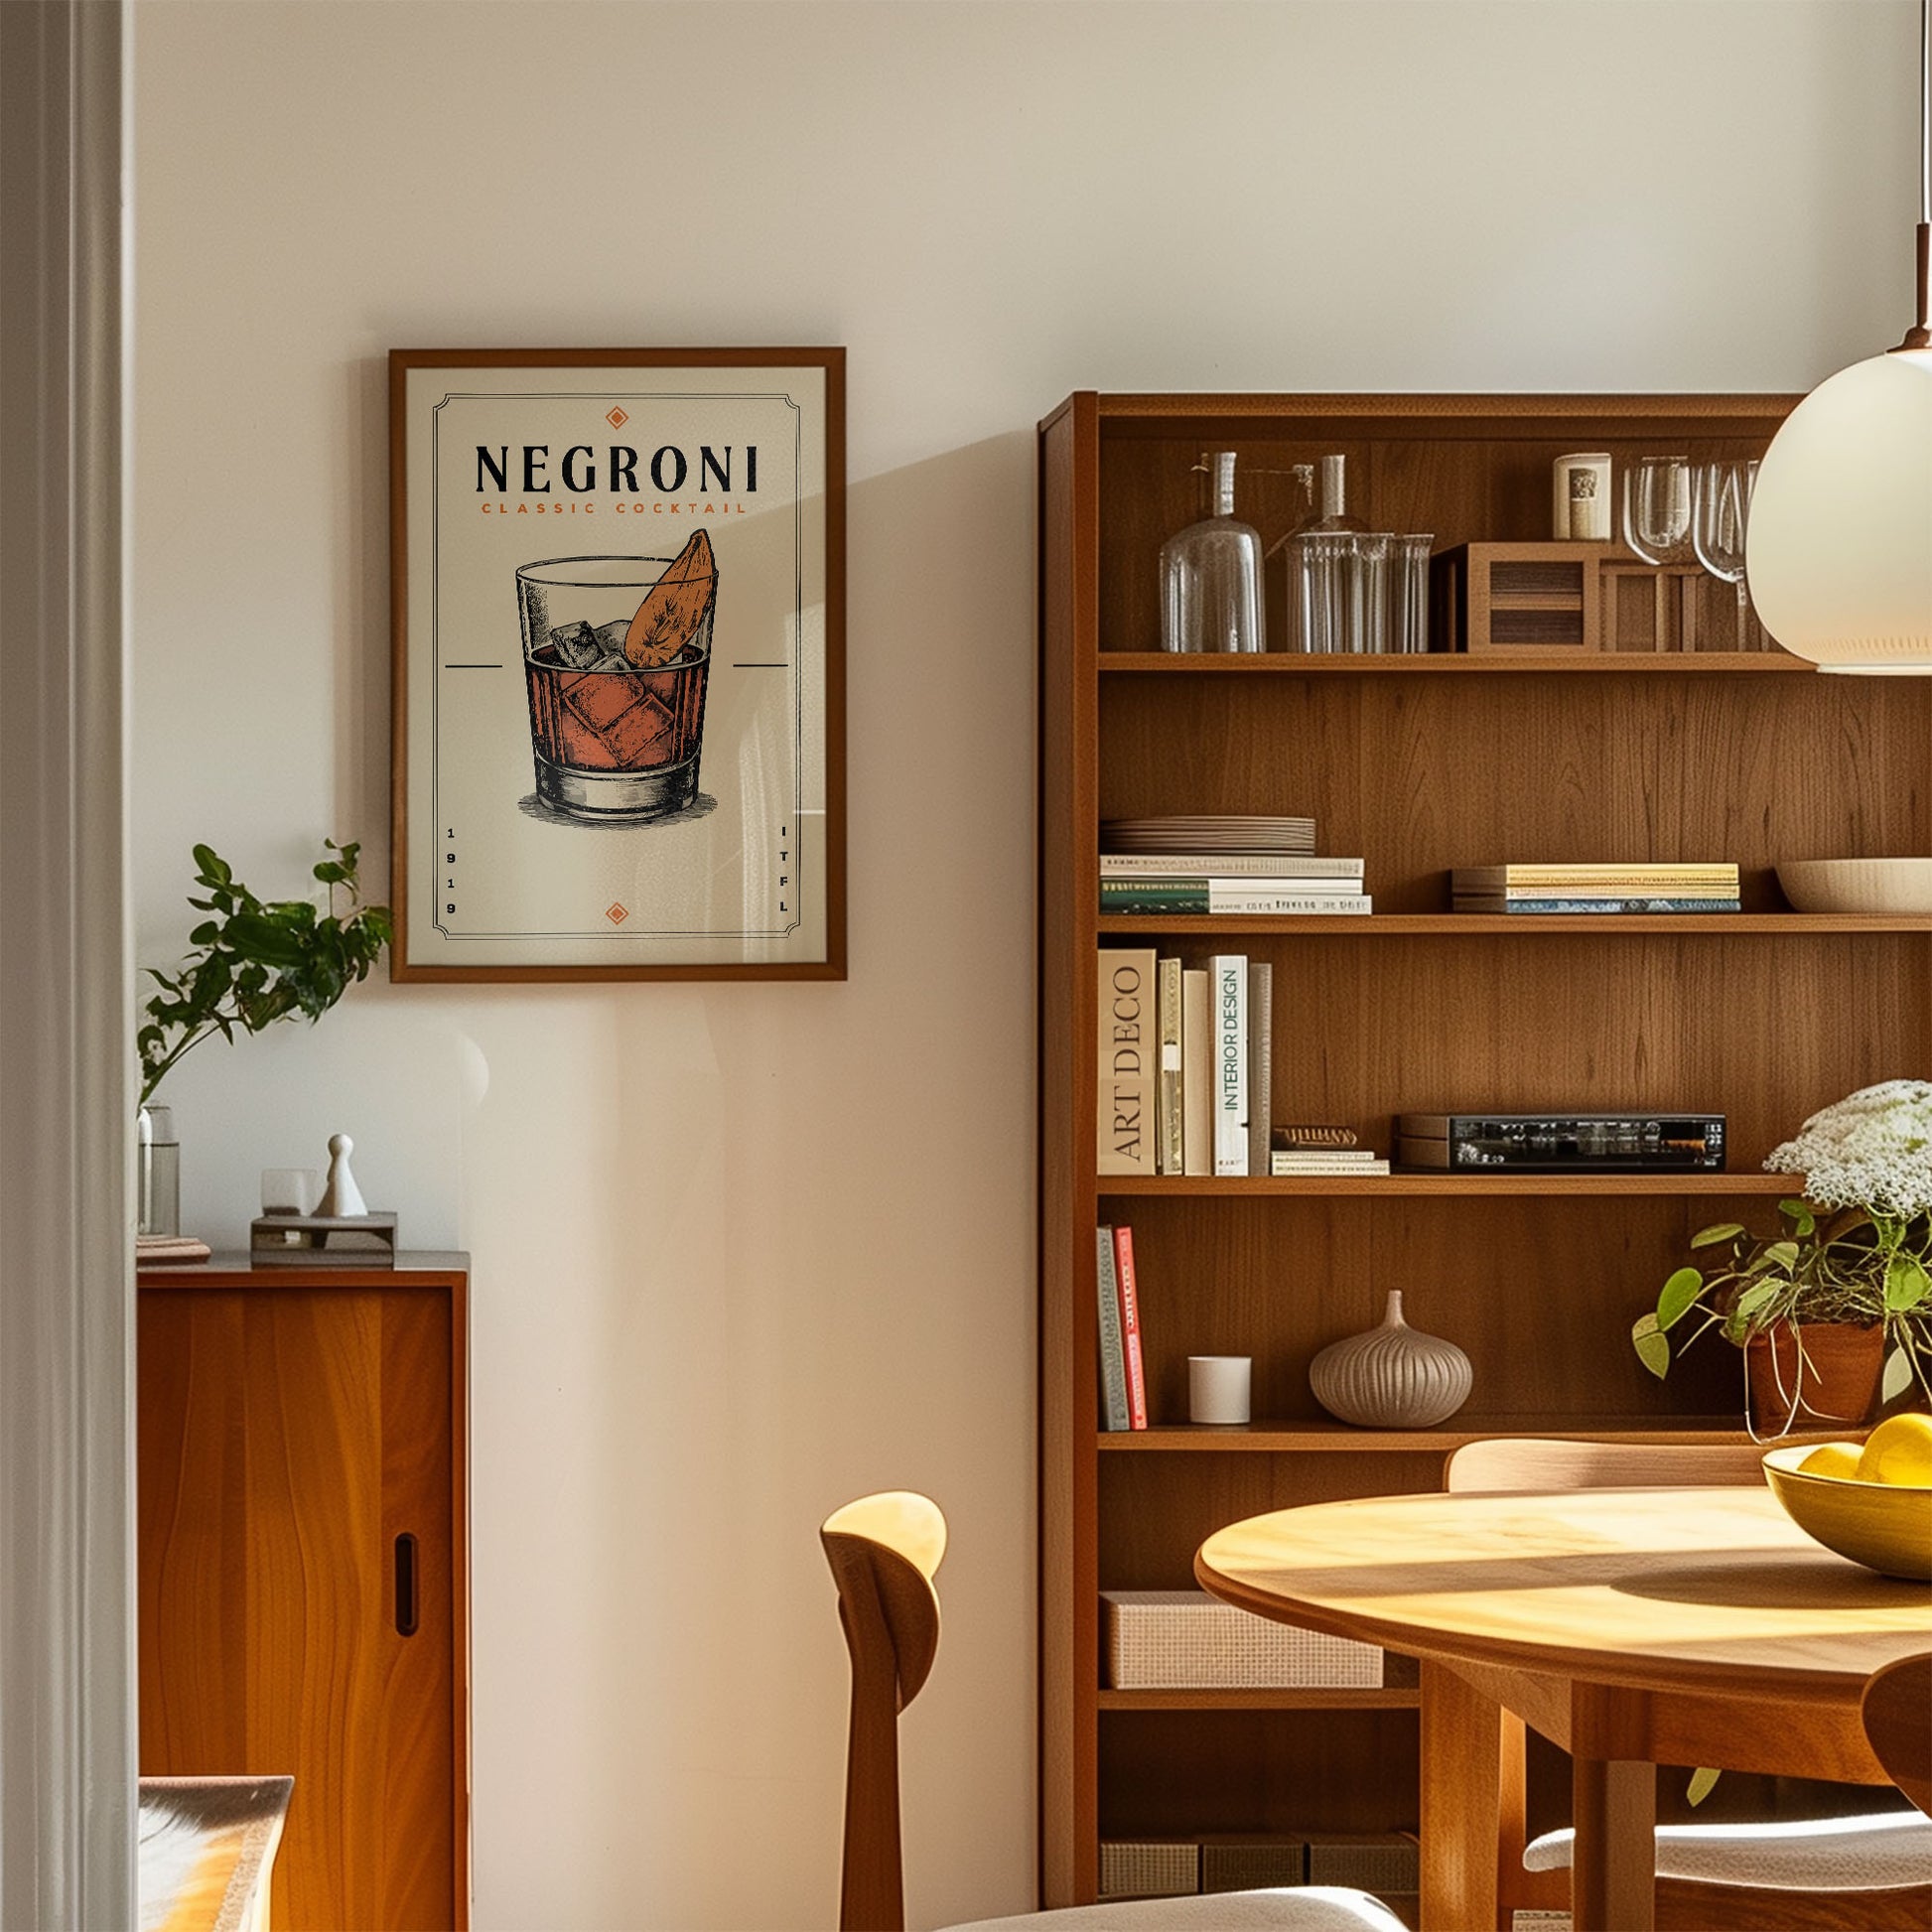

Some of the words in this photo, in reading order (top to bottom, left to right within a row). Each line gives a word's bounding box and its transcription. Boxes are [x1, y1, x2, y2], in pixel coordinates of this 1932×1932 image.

[476, 445, 758, 492] NEGRONI
[481, 502, 595, 514] CLASSIC
[616, 502, 746, 514] COCKTAIL
[1112, 966, 1141, 1076] DECO
[1222, 969, 1238, 1031] DESIGN
[1223, 1035, 1239, 1111] INTERIOR
[1113, 1085, 1141, 1162] ART
